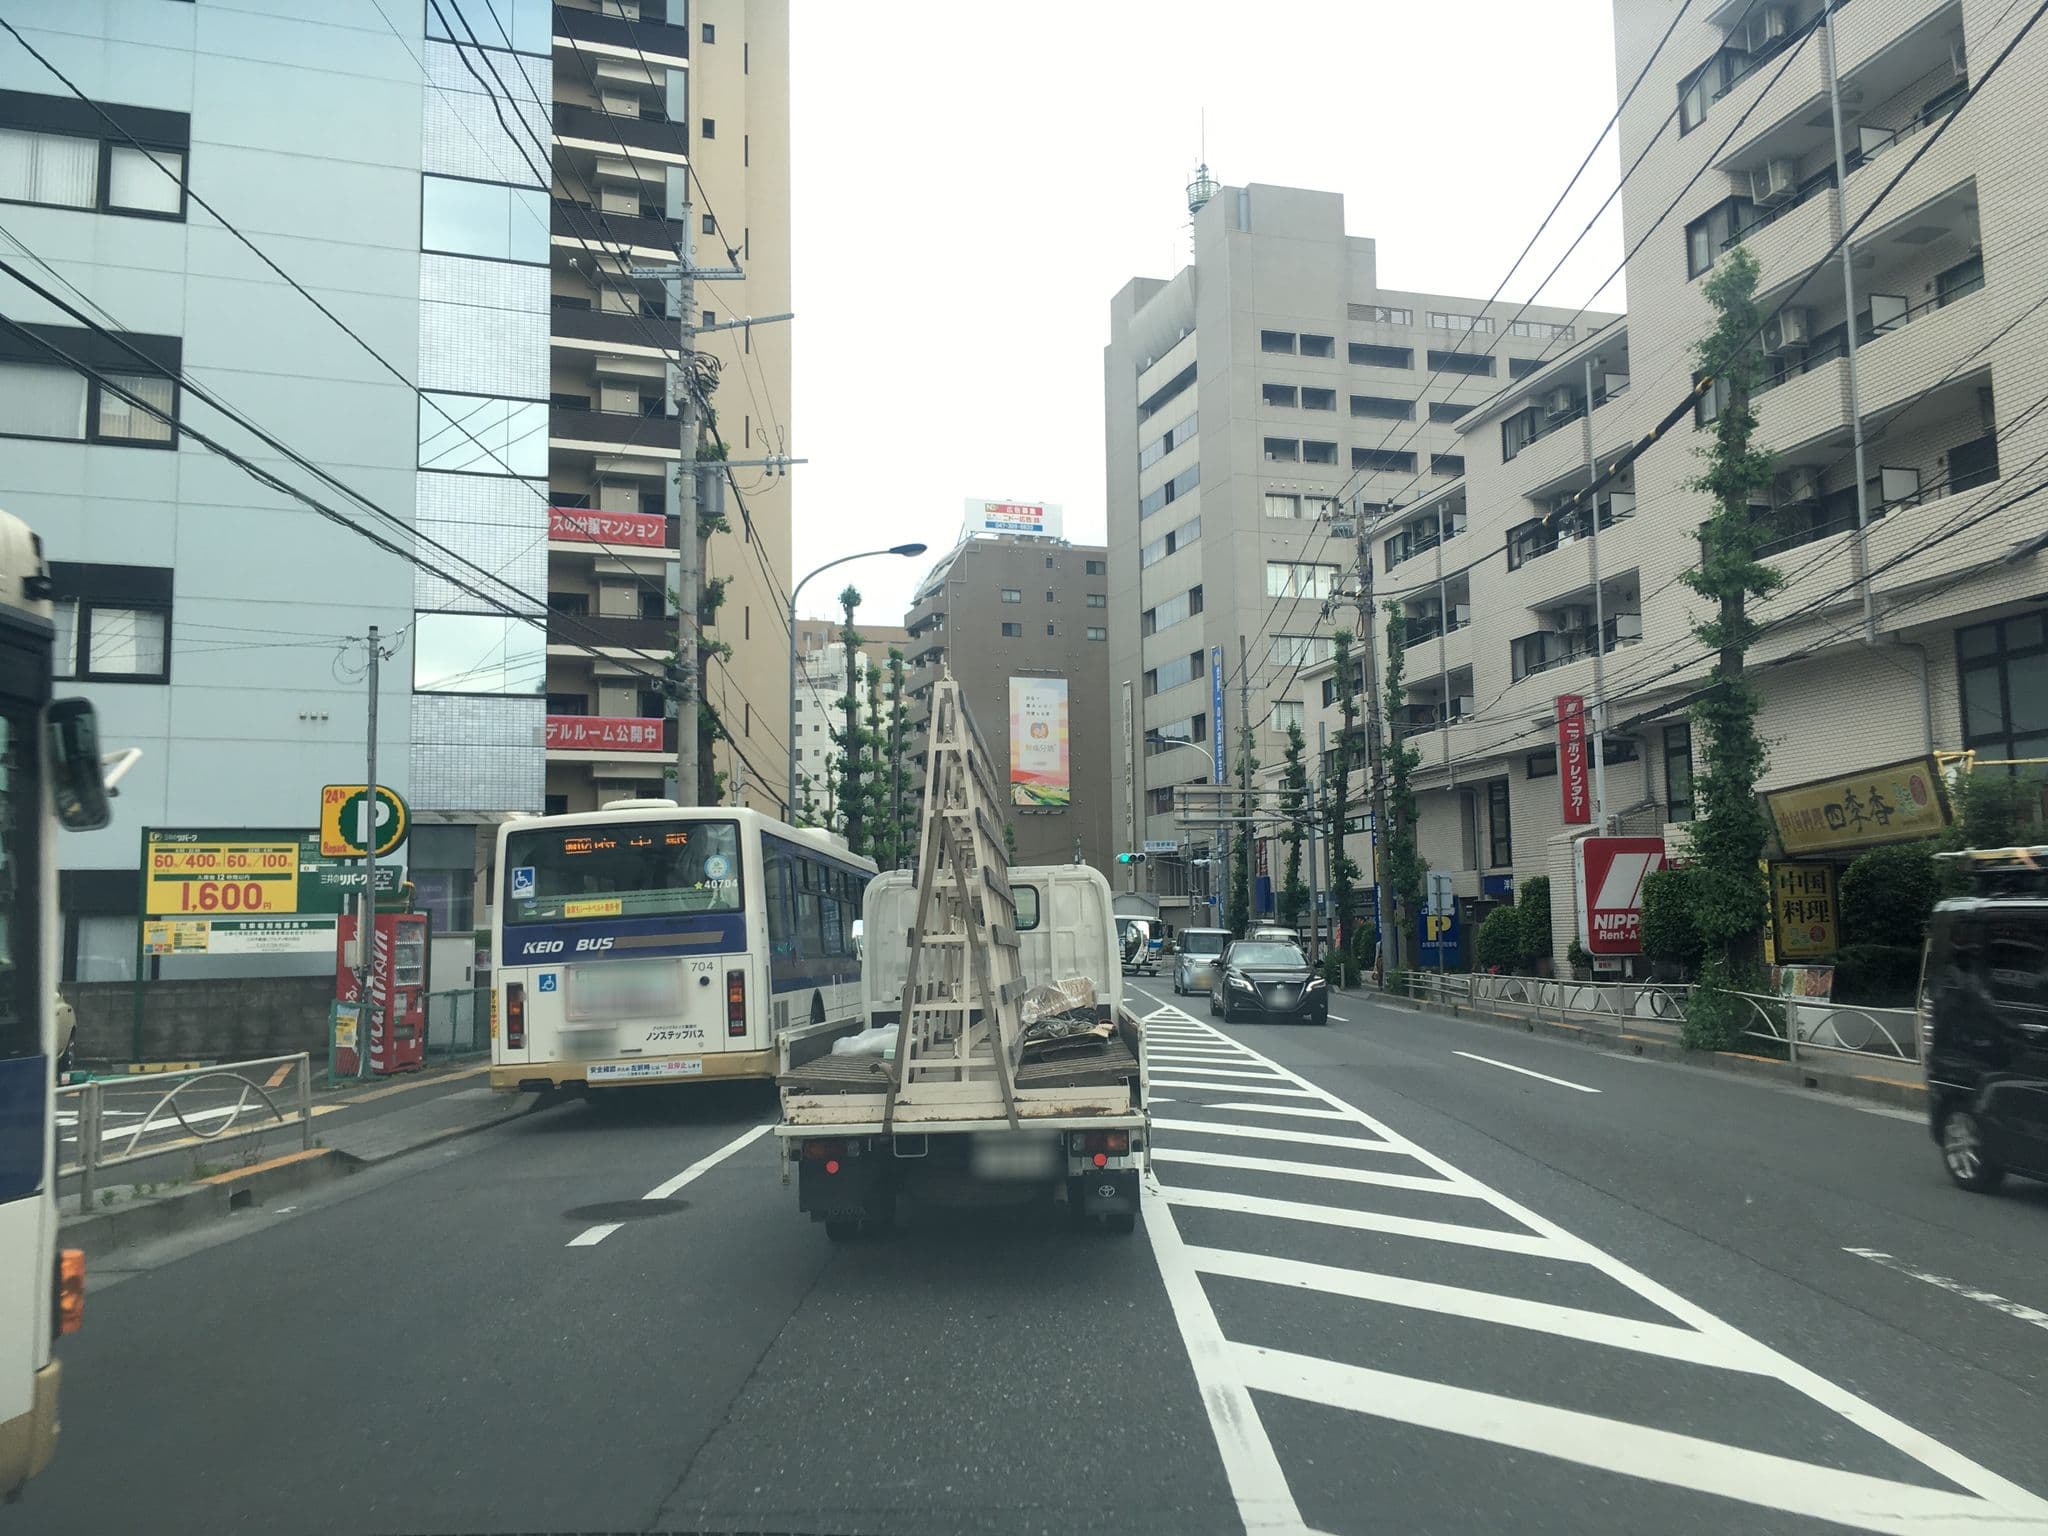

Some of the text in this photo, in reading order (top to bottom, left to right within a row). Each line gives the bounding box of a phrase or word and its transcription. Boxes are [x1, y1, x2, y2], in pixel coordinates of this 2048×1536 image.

[548, 514, 659, 538] スの分譲マンション
[546, 723, 657, 744] デルルーム公開中
[1566, 722, 1584, 817] ニッポンレンタカー
[325, 789, 346, 804] 24h
[1778, 807, 1828, 833] 中国料理
[1824, 785, 1895, 833] 四季香
[356, 800, 390, 843] P
[704, 878, 738, 889] 40704
[1780, 871, 1827, 894] 中国
[182, 882, 272, 912] 1,600円
[1594, 914, 1640, 930] NIPP
[1783, 900, 1830, 924] 料理
[1426, 916, 1452, 941] P
[522, 937, 614, 954] KEIO BUS
[690, 962, 714, 972] 704
[646, 1030, 704, 1040] ノンステップバス
